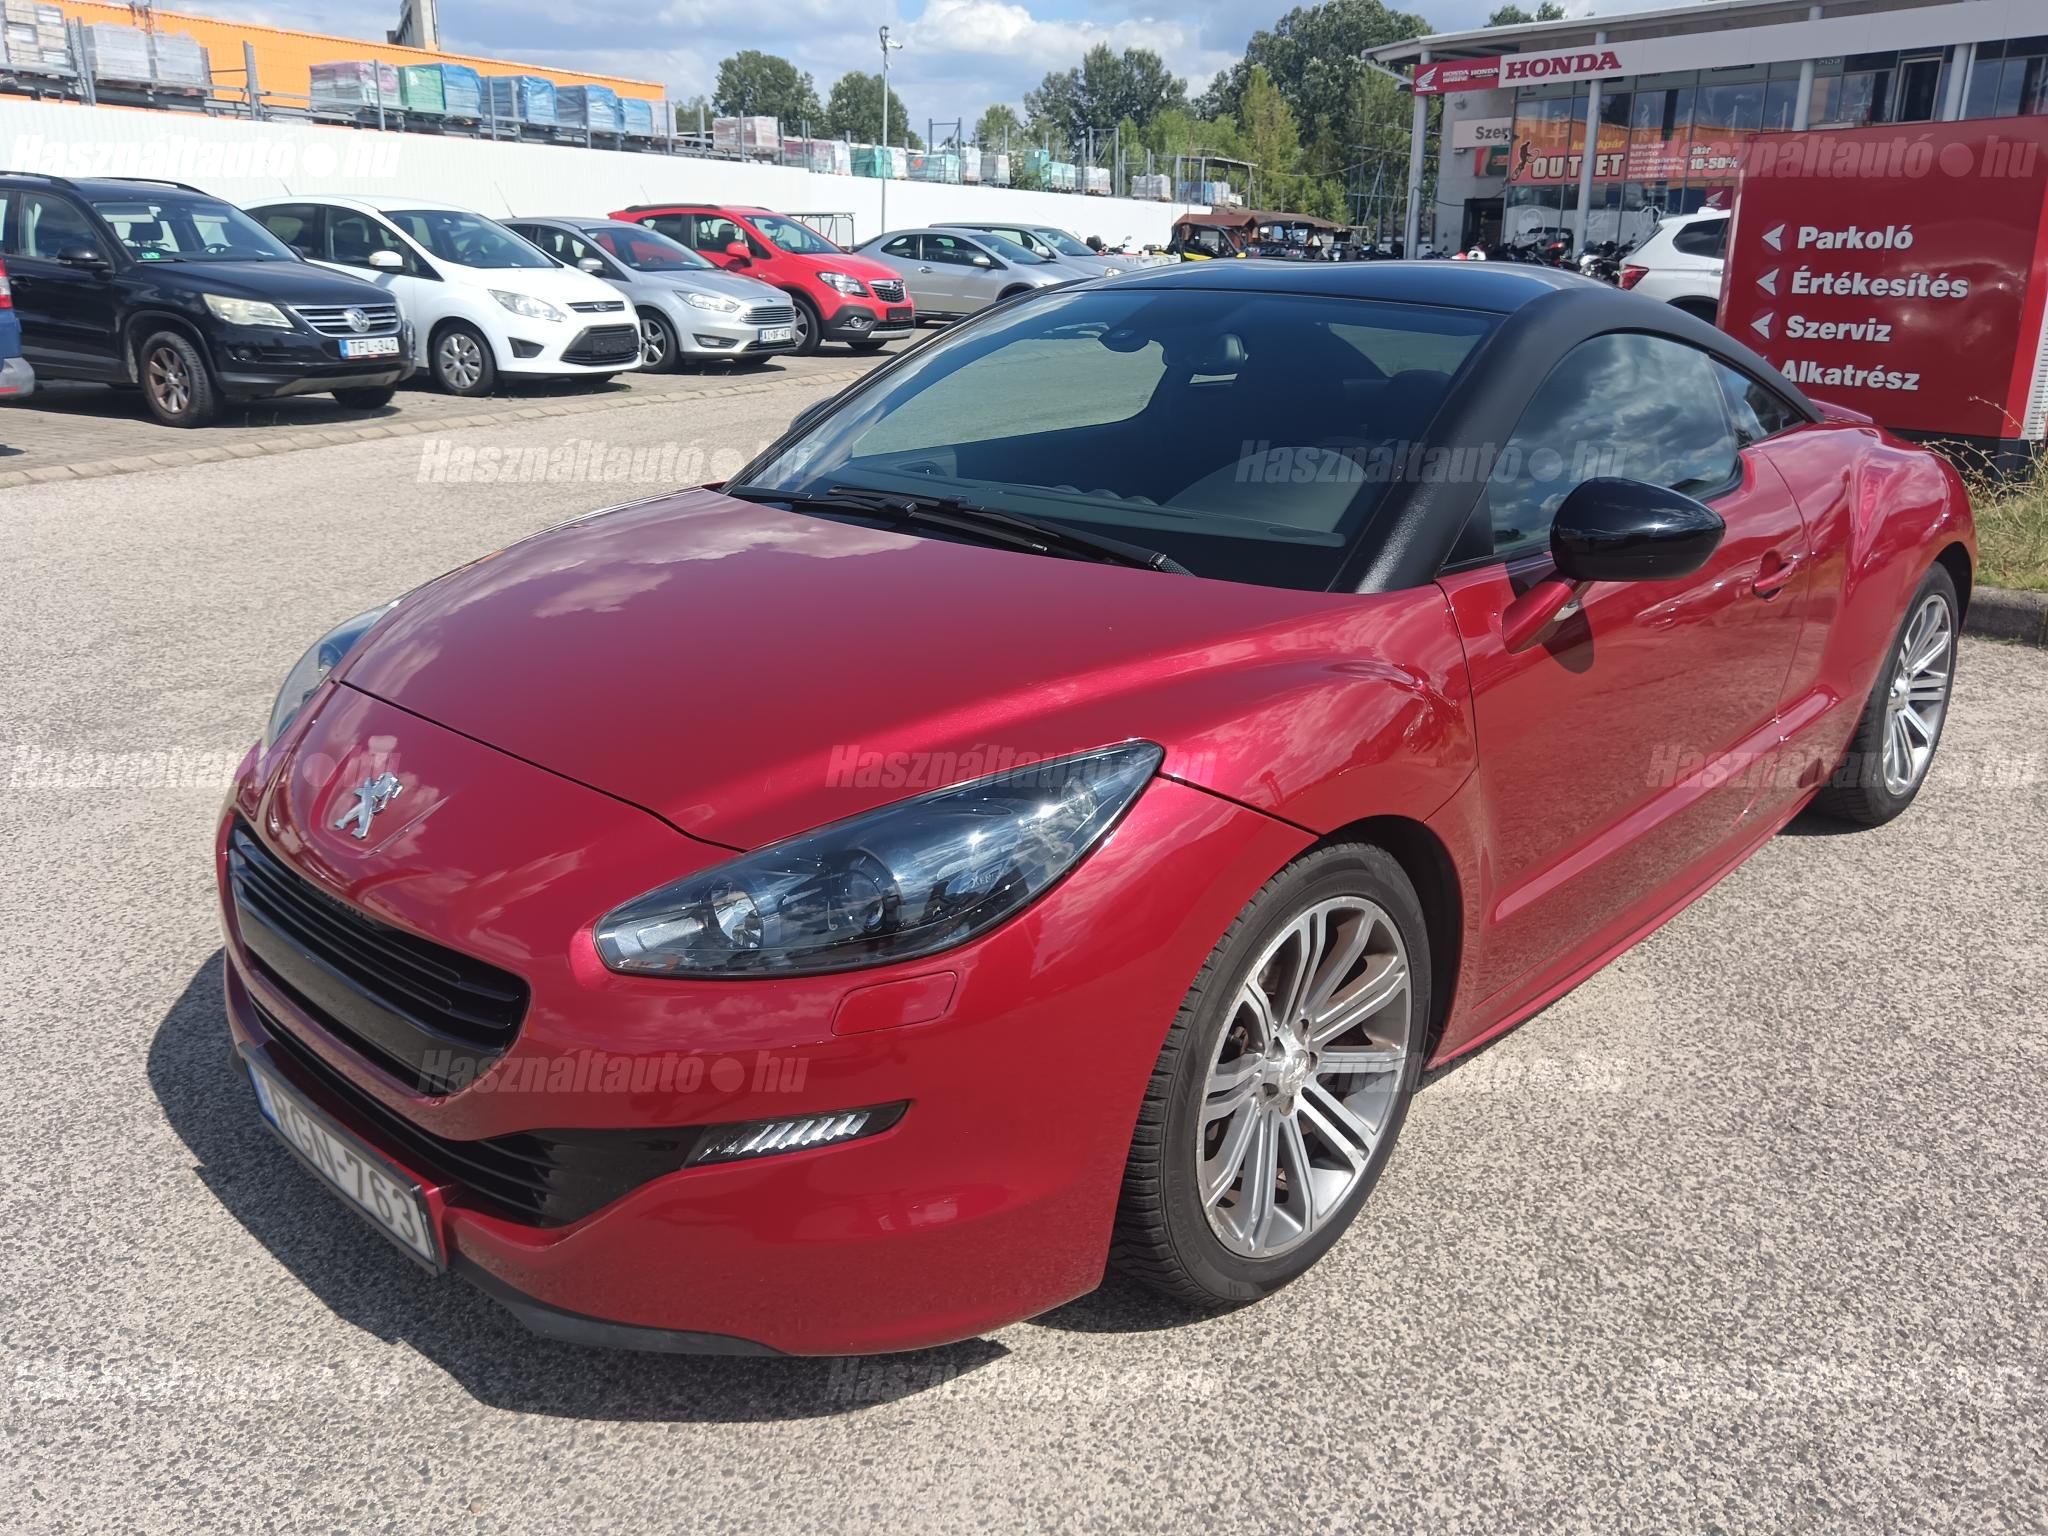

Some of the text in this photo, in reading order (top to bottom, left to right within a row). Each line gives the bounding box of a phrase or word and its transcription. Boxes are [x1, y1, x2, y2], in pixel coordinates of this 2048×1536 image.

[1505, 51, 1622, 79] HONDA
[1531, 153, 1624, 179] OUTET
[1797, 224, 1913, 250] Parkoló
[1791, 265, 1969, 298] Értékesítés
[1785, 315, 1892, 342] Szerviz
[1781, 359, 1920, 391] Alkatrész
[270, 1088, 418, 1245] RGN-763
